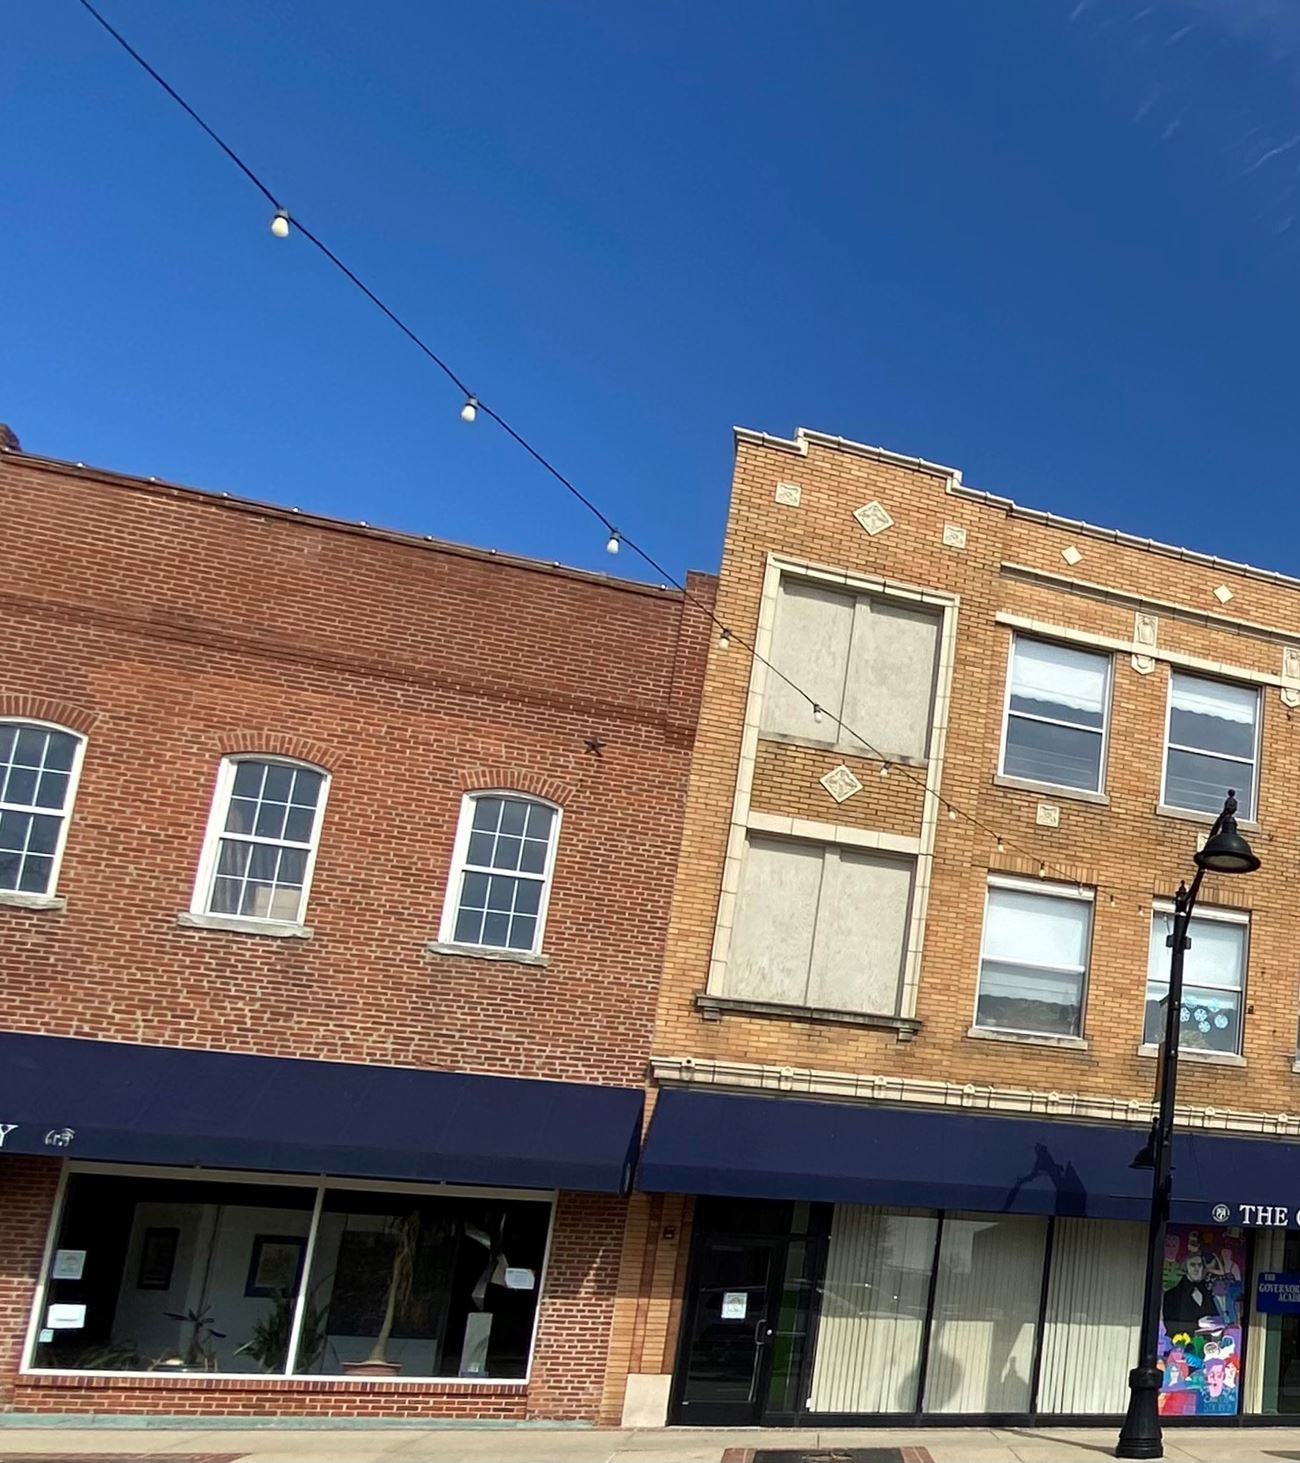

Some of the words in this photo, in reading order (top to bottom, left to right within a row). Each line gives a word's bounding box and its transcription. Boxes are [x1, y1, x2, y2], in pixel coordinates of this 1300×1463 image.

[1239, 1204, 1289, 1227] THE
[1264, 1273, 1276, 1281] THE
[1258, 1282, 1300, 1294] GOVERNOR
